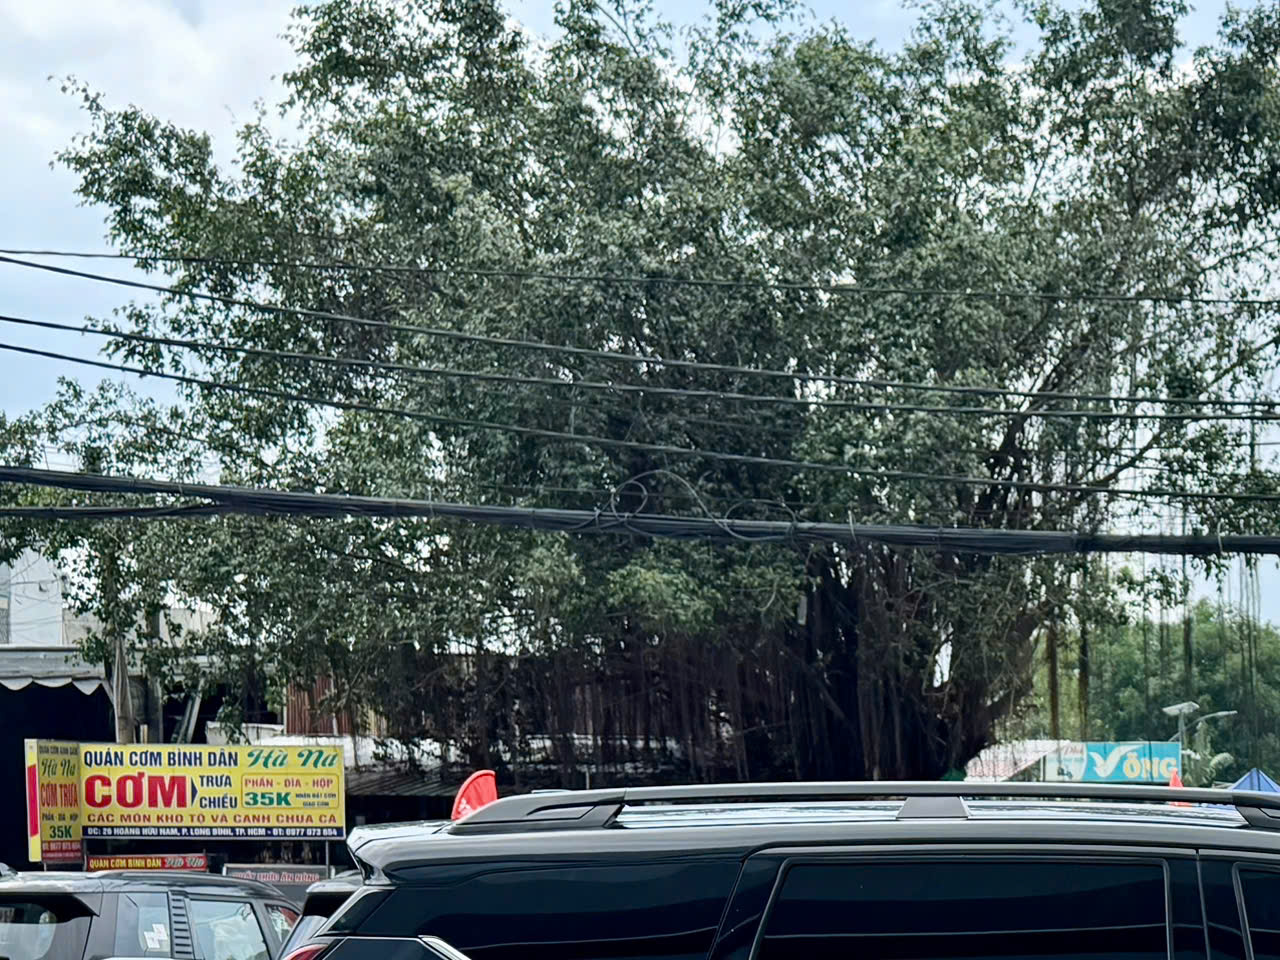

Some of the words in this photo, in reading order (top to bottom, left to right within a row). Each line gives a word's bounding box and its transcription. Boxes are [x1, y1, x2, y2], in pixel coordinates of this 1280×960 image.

[129, 749, 162, 767] CƠM
[167, 748, 203, 767] BÌNH
[208, 748, 239, 767] DÂN
[247, 748, 289, 769] Hà
[297, 748, 338, 769] Na
[199, 774, 232, 788] TRƯA
[84, 771, 188, 809] CƠM
[244, 791, 292, 807] 35K
[157, 812, 184, 824] KHO
[233, 813, 271, 824] CANH
[276, 813, 314, 824] CHUA
[49, 825, 72, 839] 35K
